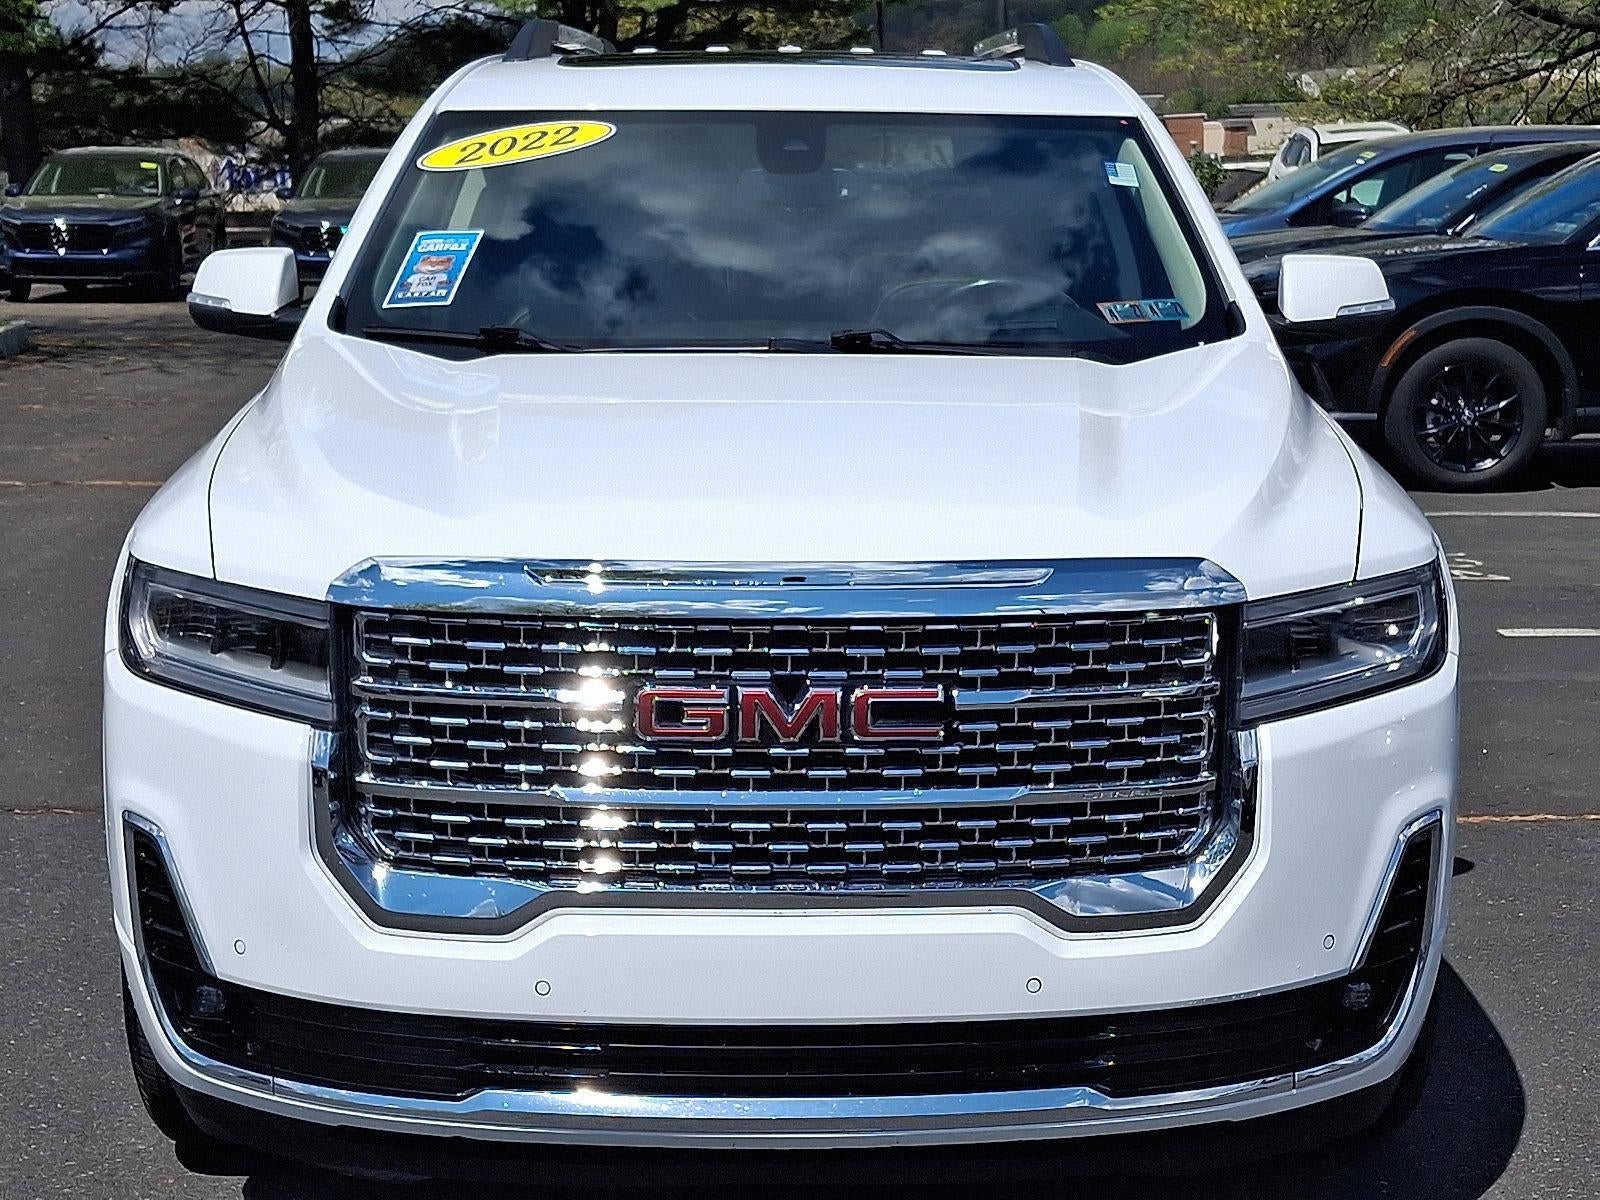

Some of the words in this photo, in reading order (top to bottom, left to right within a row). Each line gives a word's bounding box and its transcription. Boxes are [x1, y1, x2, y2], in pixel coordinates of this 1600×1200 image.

[454, 126, 580, 165] 2022
[417, 242, 469, 252] CARFAX
[636, 686, 945, 742] GMC
